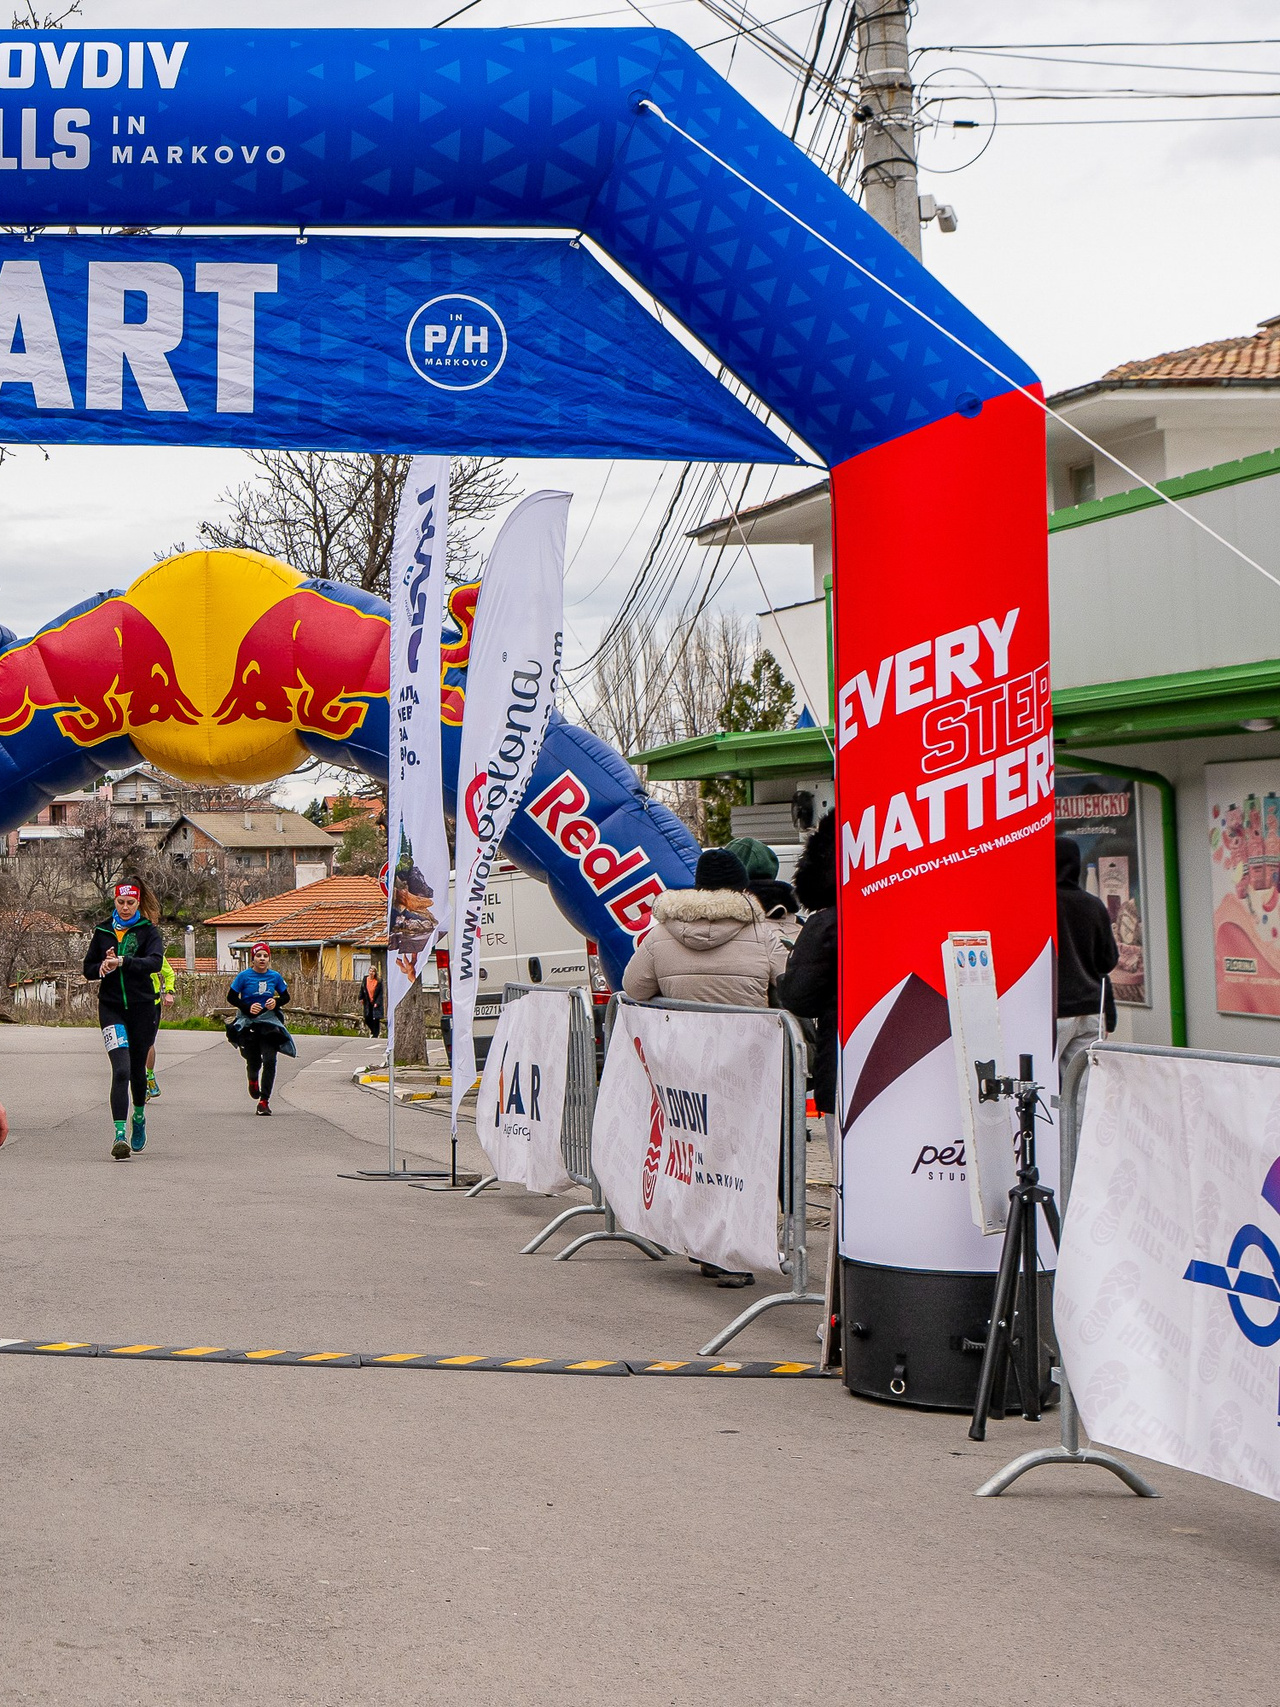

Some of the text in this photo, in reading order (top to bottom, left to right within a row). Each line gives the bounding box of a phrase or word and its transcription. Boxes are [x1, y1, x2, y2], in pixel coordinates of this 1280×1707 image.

[112, 115, 147, 136] IN
[111, 145, 287, 165] MARKOVO
[449, 313, 463, 321] IN
[424, 324, 488, 356] P/H
[424, 358, 488, 367] MARKOVO
[839, 606, 1020, 751] EVERY
[528, 772, 647, 892] Red
[695, 1151, 704, 1166] IN
[928, 1171, 966, 1181] STUD
